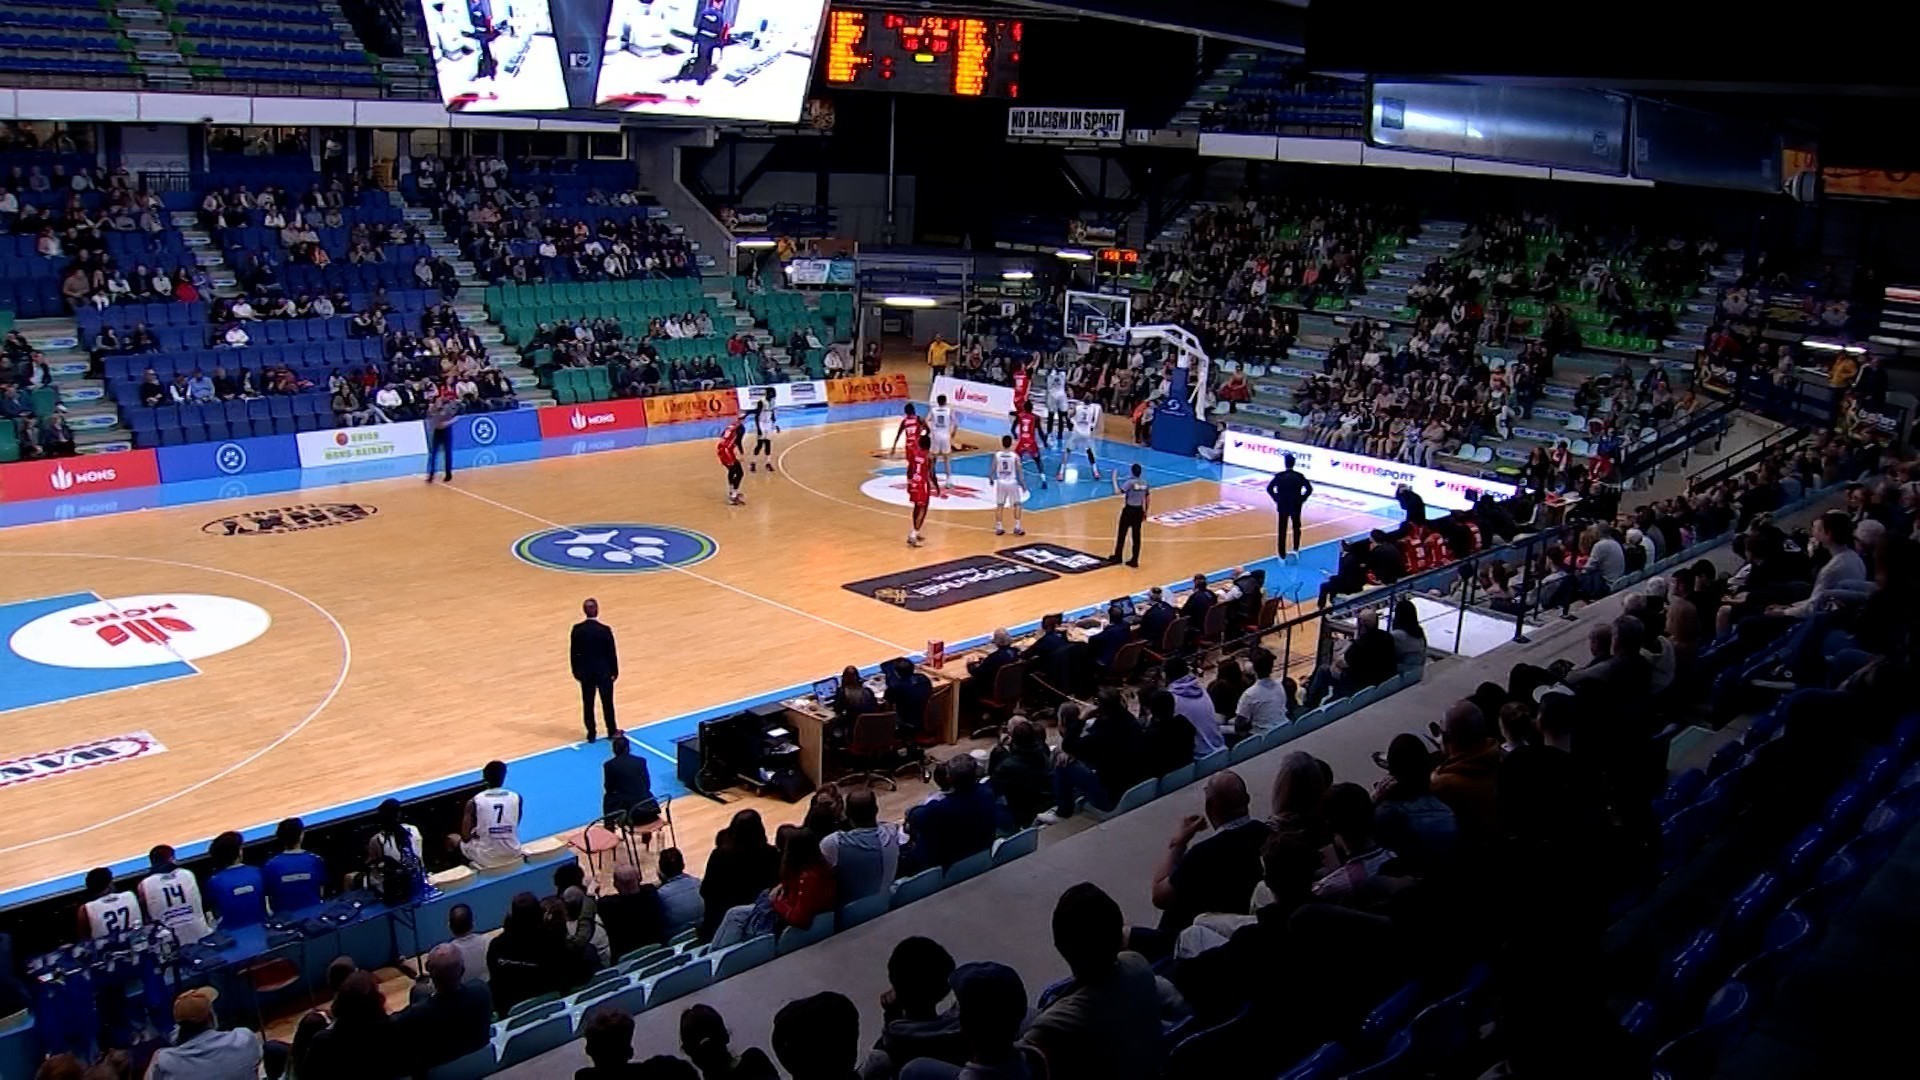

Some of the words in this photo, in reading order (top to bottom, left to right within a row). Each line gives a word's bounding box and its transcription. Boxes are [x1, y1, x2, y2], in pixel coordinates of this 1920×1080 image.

[1011, 111, 1025, 128] NO
[1027, 111, 1068, 129] RACISM
[1070, 112, 1082, 129] IN
[1084, 112, 1120, 131] SPORT
[587, 413, 616, 424] MONS
[75, 468, 117, 484] MONS
[1342, 461, 1415, 482] INTERSPORT
[69, 602, 178, 627] MONS
[493, 803, 504, 824] 7
[163, 884, 186, 908] 14
[104, 906, 130, 933] 27
